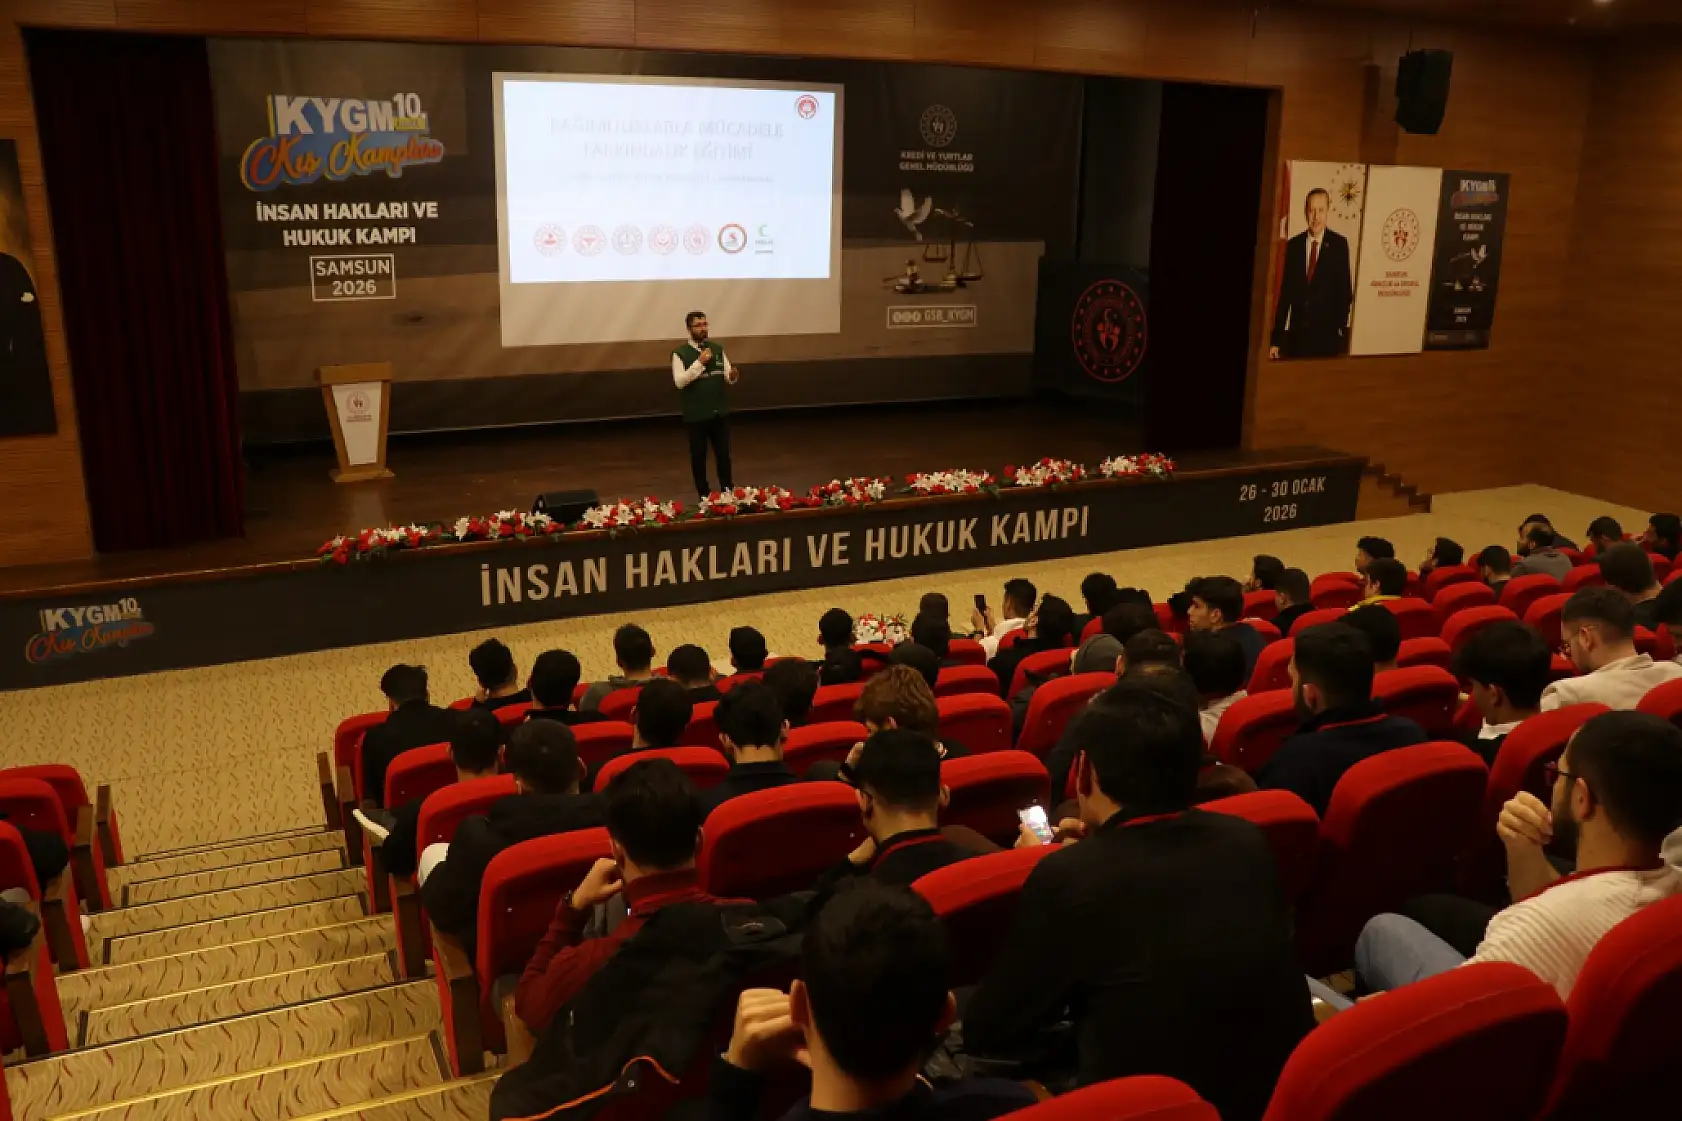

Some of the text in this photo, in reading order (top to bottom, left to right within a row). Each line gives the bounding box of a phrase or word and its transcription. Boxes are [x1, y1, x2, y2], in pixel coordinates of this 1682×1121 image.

[275, 95, 394, 134] KYGM
[256, 201, 439, 221] İNSAN HAKLARI VE
[283, 227, 416, 246] HUKUK KAMPI
[315, 260, 390, 276] SAMSUN
[332, 280, 377, 296] 2026
[924, 308, 973, 323] GSB_KYGM
[1239, 483, 1257, 501] 26
[1271, 480, 1288, 497] 30
[1292, 476, 1326, 495] OCAK
[1263, 503, 1297, 522] 2026
[481, 505, 1090, 606] İNSAN HAKLARI VE HUKUK KAMPI
[45, 604, 122, 632] KYGM
